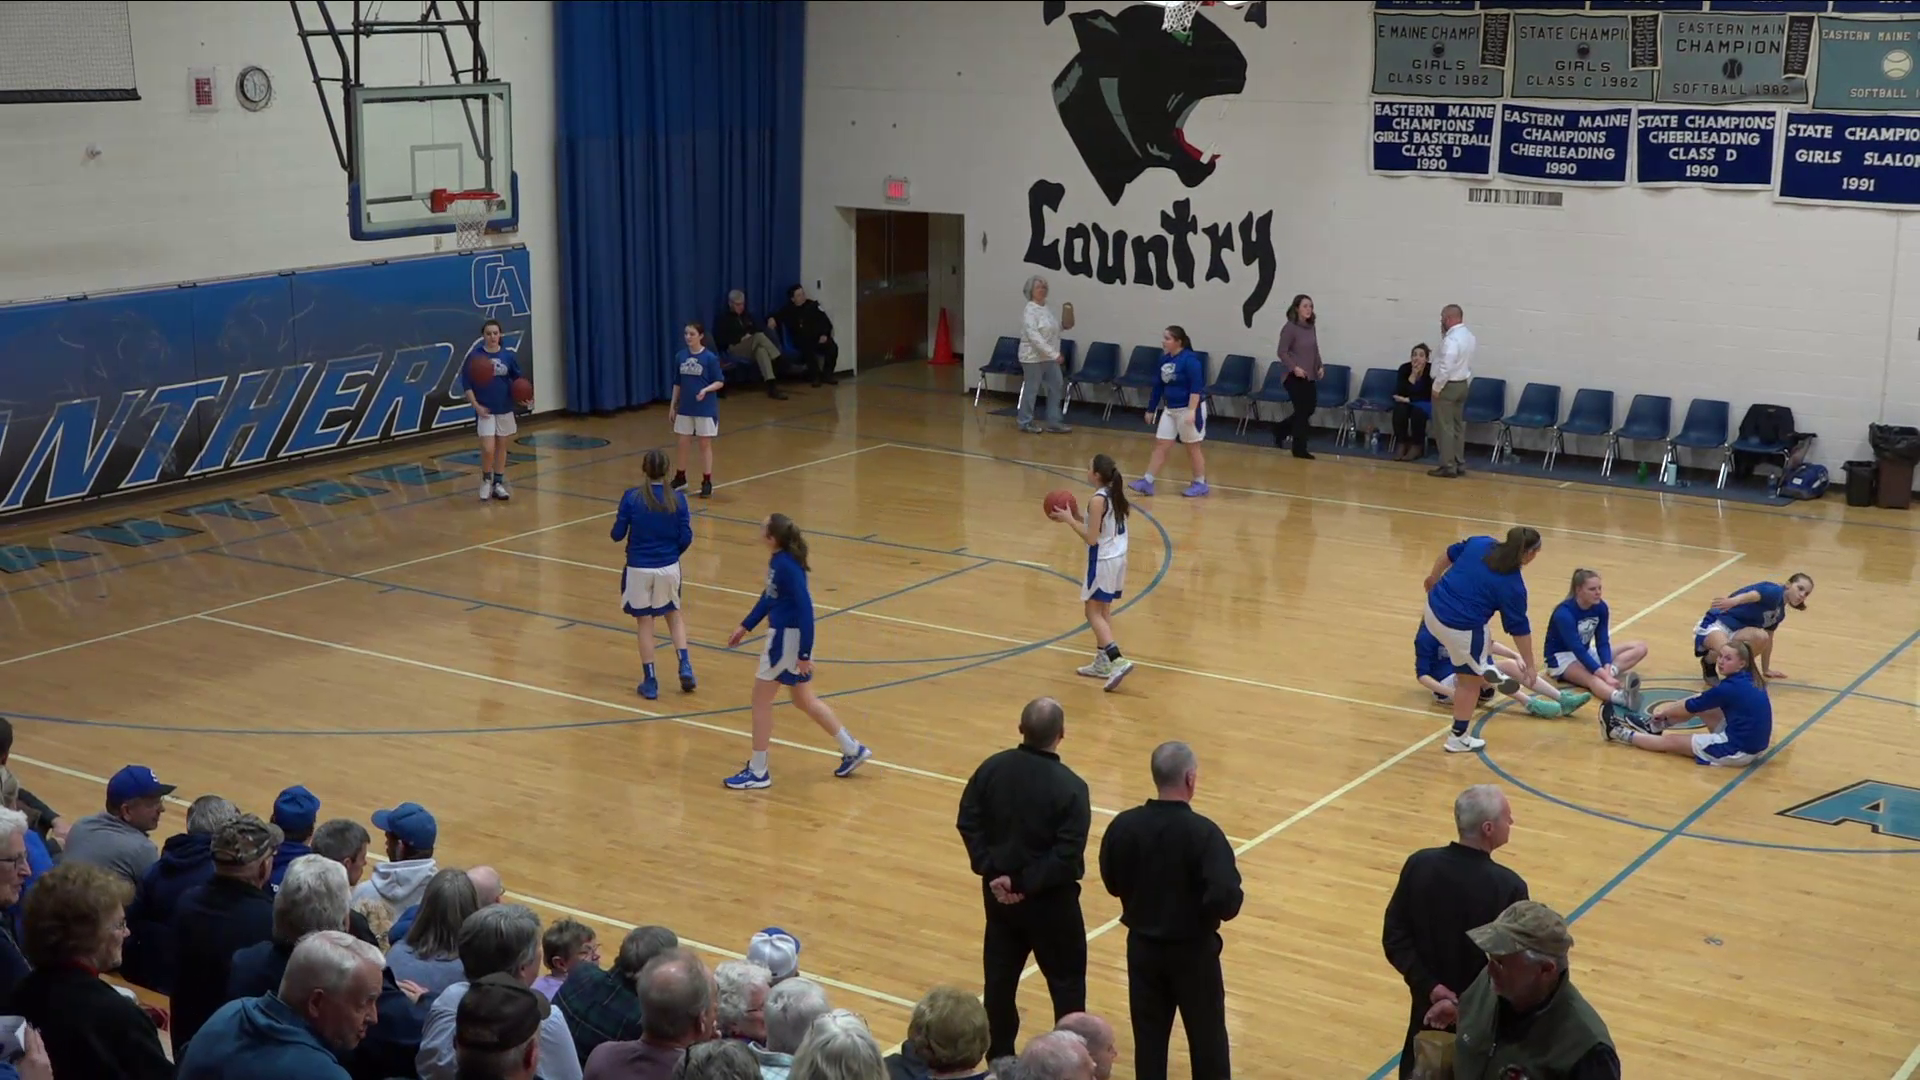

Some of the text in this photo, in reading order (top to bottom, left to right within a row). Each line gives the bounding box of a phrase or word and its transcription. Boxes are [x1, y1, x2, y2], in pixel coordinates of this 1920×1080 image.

[1379, 25, 1386, 38] E
[1390, 26, 1428, 39] MAINE
[1520, 26, 1564, 40] STATE
[1678, 22, 1744, 35] EASTERN
[1822, 30, 1871, 40] EASTERN
[1877, 31, 1911, 41] MAINE
[1676, 38, 1781, 54] CHAMPION
[1412, 59, 1466, 71] GIRLS
[1555, 60, 1611, 72] GIRLS
[1388, 73, 1489, 86] CLASS C 1982
[1526, 75, 1639, 88] CLASS C 1982
[1673, 83, 1790, 96] SOFTBALL 1982
[1850, 88, 1907, 98] SOFTBALL
[1375, 104, 1494, 118] EASTERN MAINE
[1392, 118, 1475, 132] CHAMPIONS
[1504, 110, 1629, 128] EASTERN MAINE
[1638, 115, 1775, 130] STATE CHAMPIONS
[1374, 131, 1490, 146] GIRLS BASKETBALL
[1522, 128, 1607, 143] CHAMPIONS
[1649, 131, 1761, 145] CHEERLEADING
[1788, 124, 1920, 141] STATE CHAMPIO
[1402, 145, 1462, 158] CLASS D
[1510, 143, 1616, 160] CHEERLEADING
[1668, 147, 1737, 161] CLASS D
[1795, 149, 1842, 164] GIRLS
[1416, 158, 1447, 170] 1990
[1545, 162, 1577, 175] 1990
[1685, 164, 1719, 177] 1990
[1842, 177, 1875, 191] 1991
[1023, 179, 1277, 329] Country
